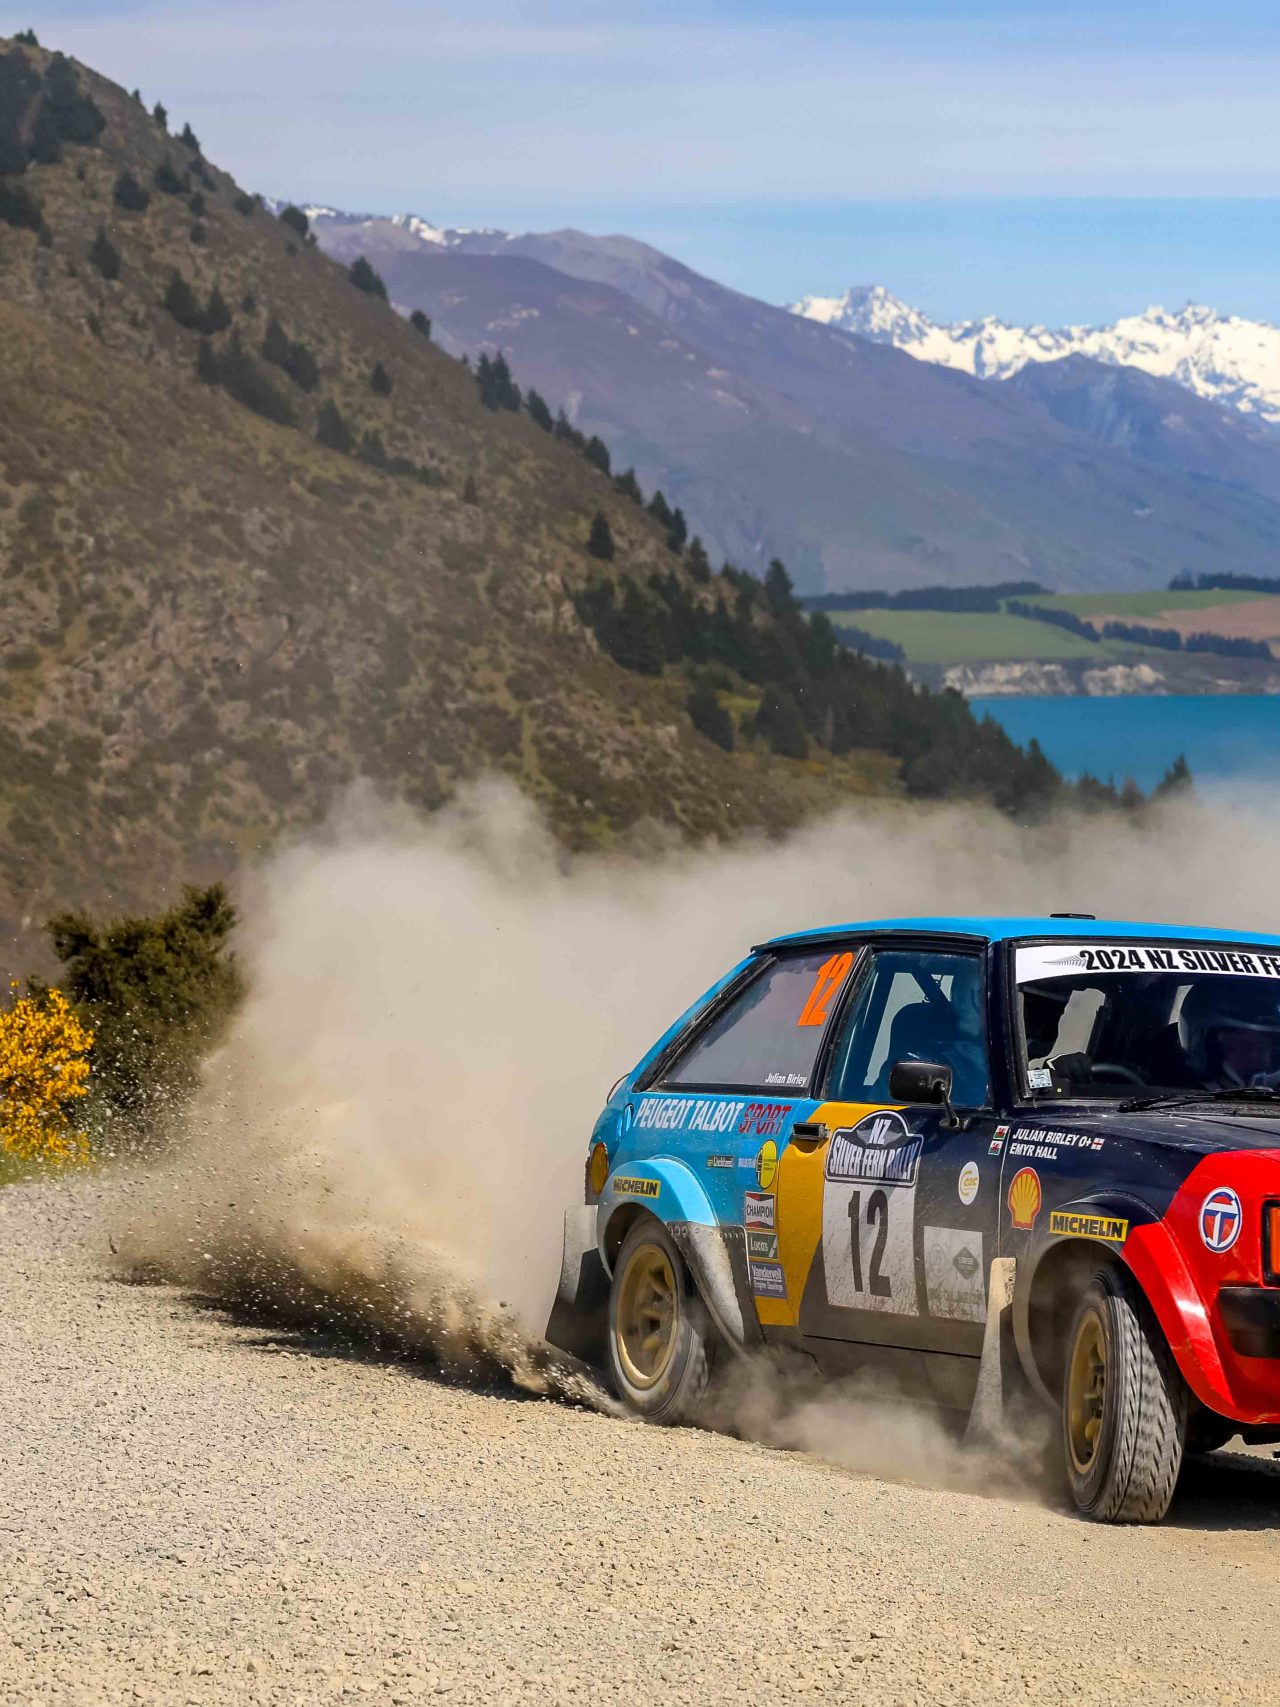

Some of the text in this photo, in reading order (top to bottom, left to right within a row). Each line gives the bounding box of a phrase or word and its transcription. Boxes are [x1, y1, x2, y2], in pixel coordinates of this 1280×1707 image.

[1080, 950, 1145, 970] 2024
[1145, 950, 1179, 969] NZ
[1178, 950, 1259, 974] SILVER
[797, 952, 854, 1026] 12
[765, 1073, 808, 1087] Julian Birley
[633, 1098, 792, 1135] PEUGEOT TALBOT SPORT
[869, 1119, 892, 1145] NZ
[1012, 1129, 1046, 1142] JULIAN
[1046, 1132, 1080, 1146] BIRLEY
[829, 1136, 920, 1180] SILVER FERN RALLY
[1009, 1143, 1058, 1160] EMYR HALL
[613, 1179, 658, 1195] MICHELIN
[746, 1204, 773, 1218] CHAMPION
[1052, 1215, 1123, 1239] MICHELIN
[750, 1234, 769, 1252] Lucas
[848, 1190, 892, 1297] 12
